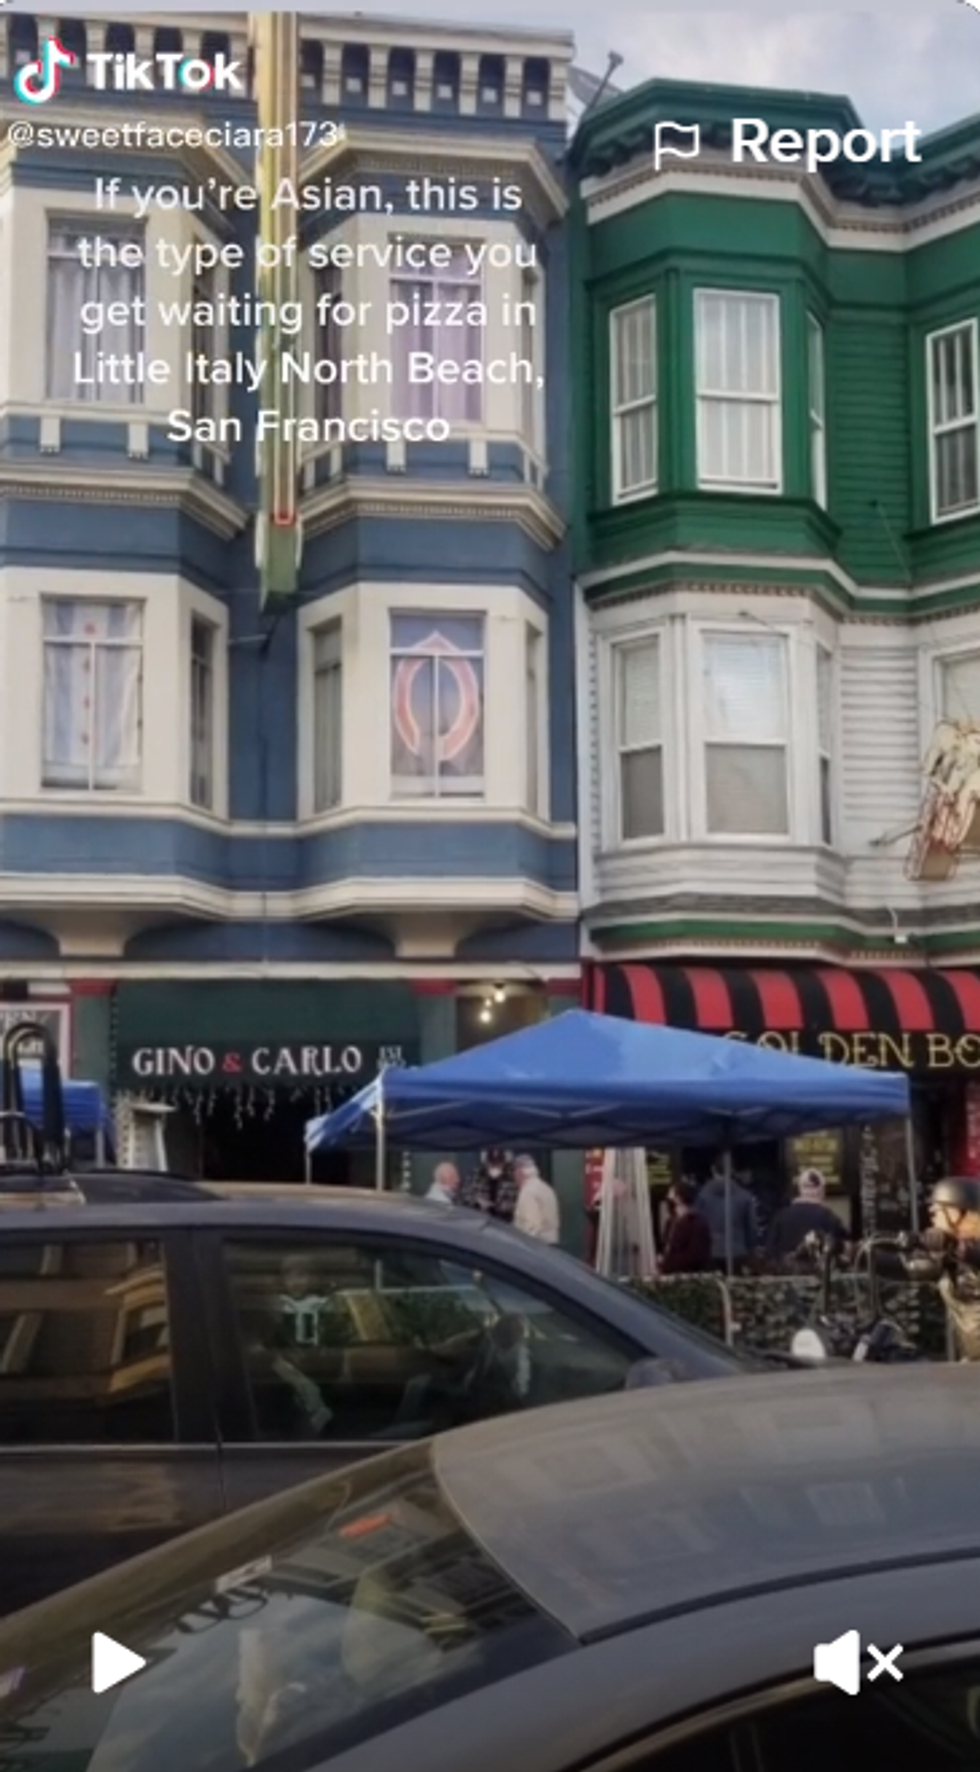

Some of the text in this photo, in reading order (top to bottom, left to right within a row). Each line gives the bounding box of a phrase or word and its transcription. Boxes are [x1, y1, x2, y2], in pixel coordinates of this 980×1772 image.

[132, 1046, 215, 1076] GINO
[222, 1053, 242, 1073] &
[251, 1046, 362, 1076] CARLO
[724, 1030, 914, 1068] OLDEN
